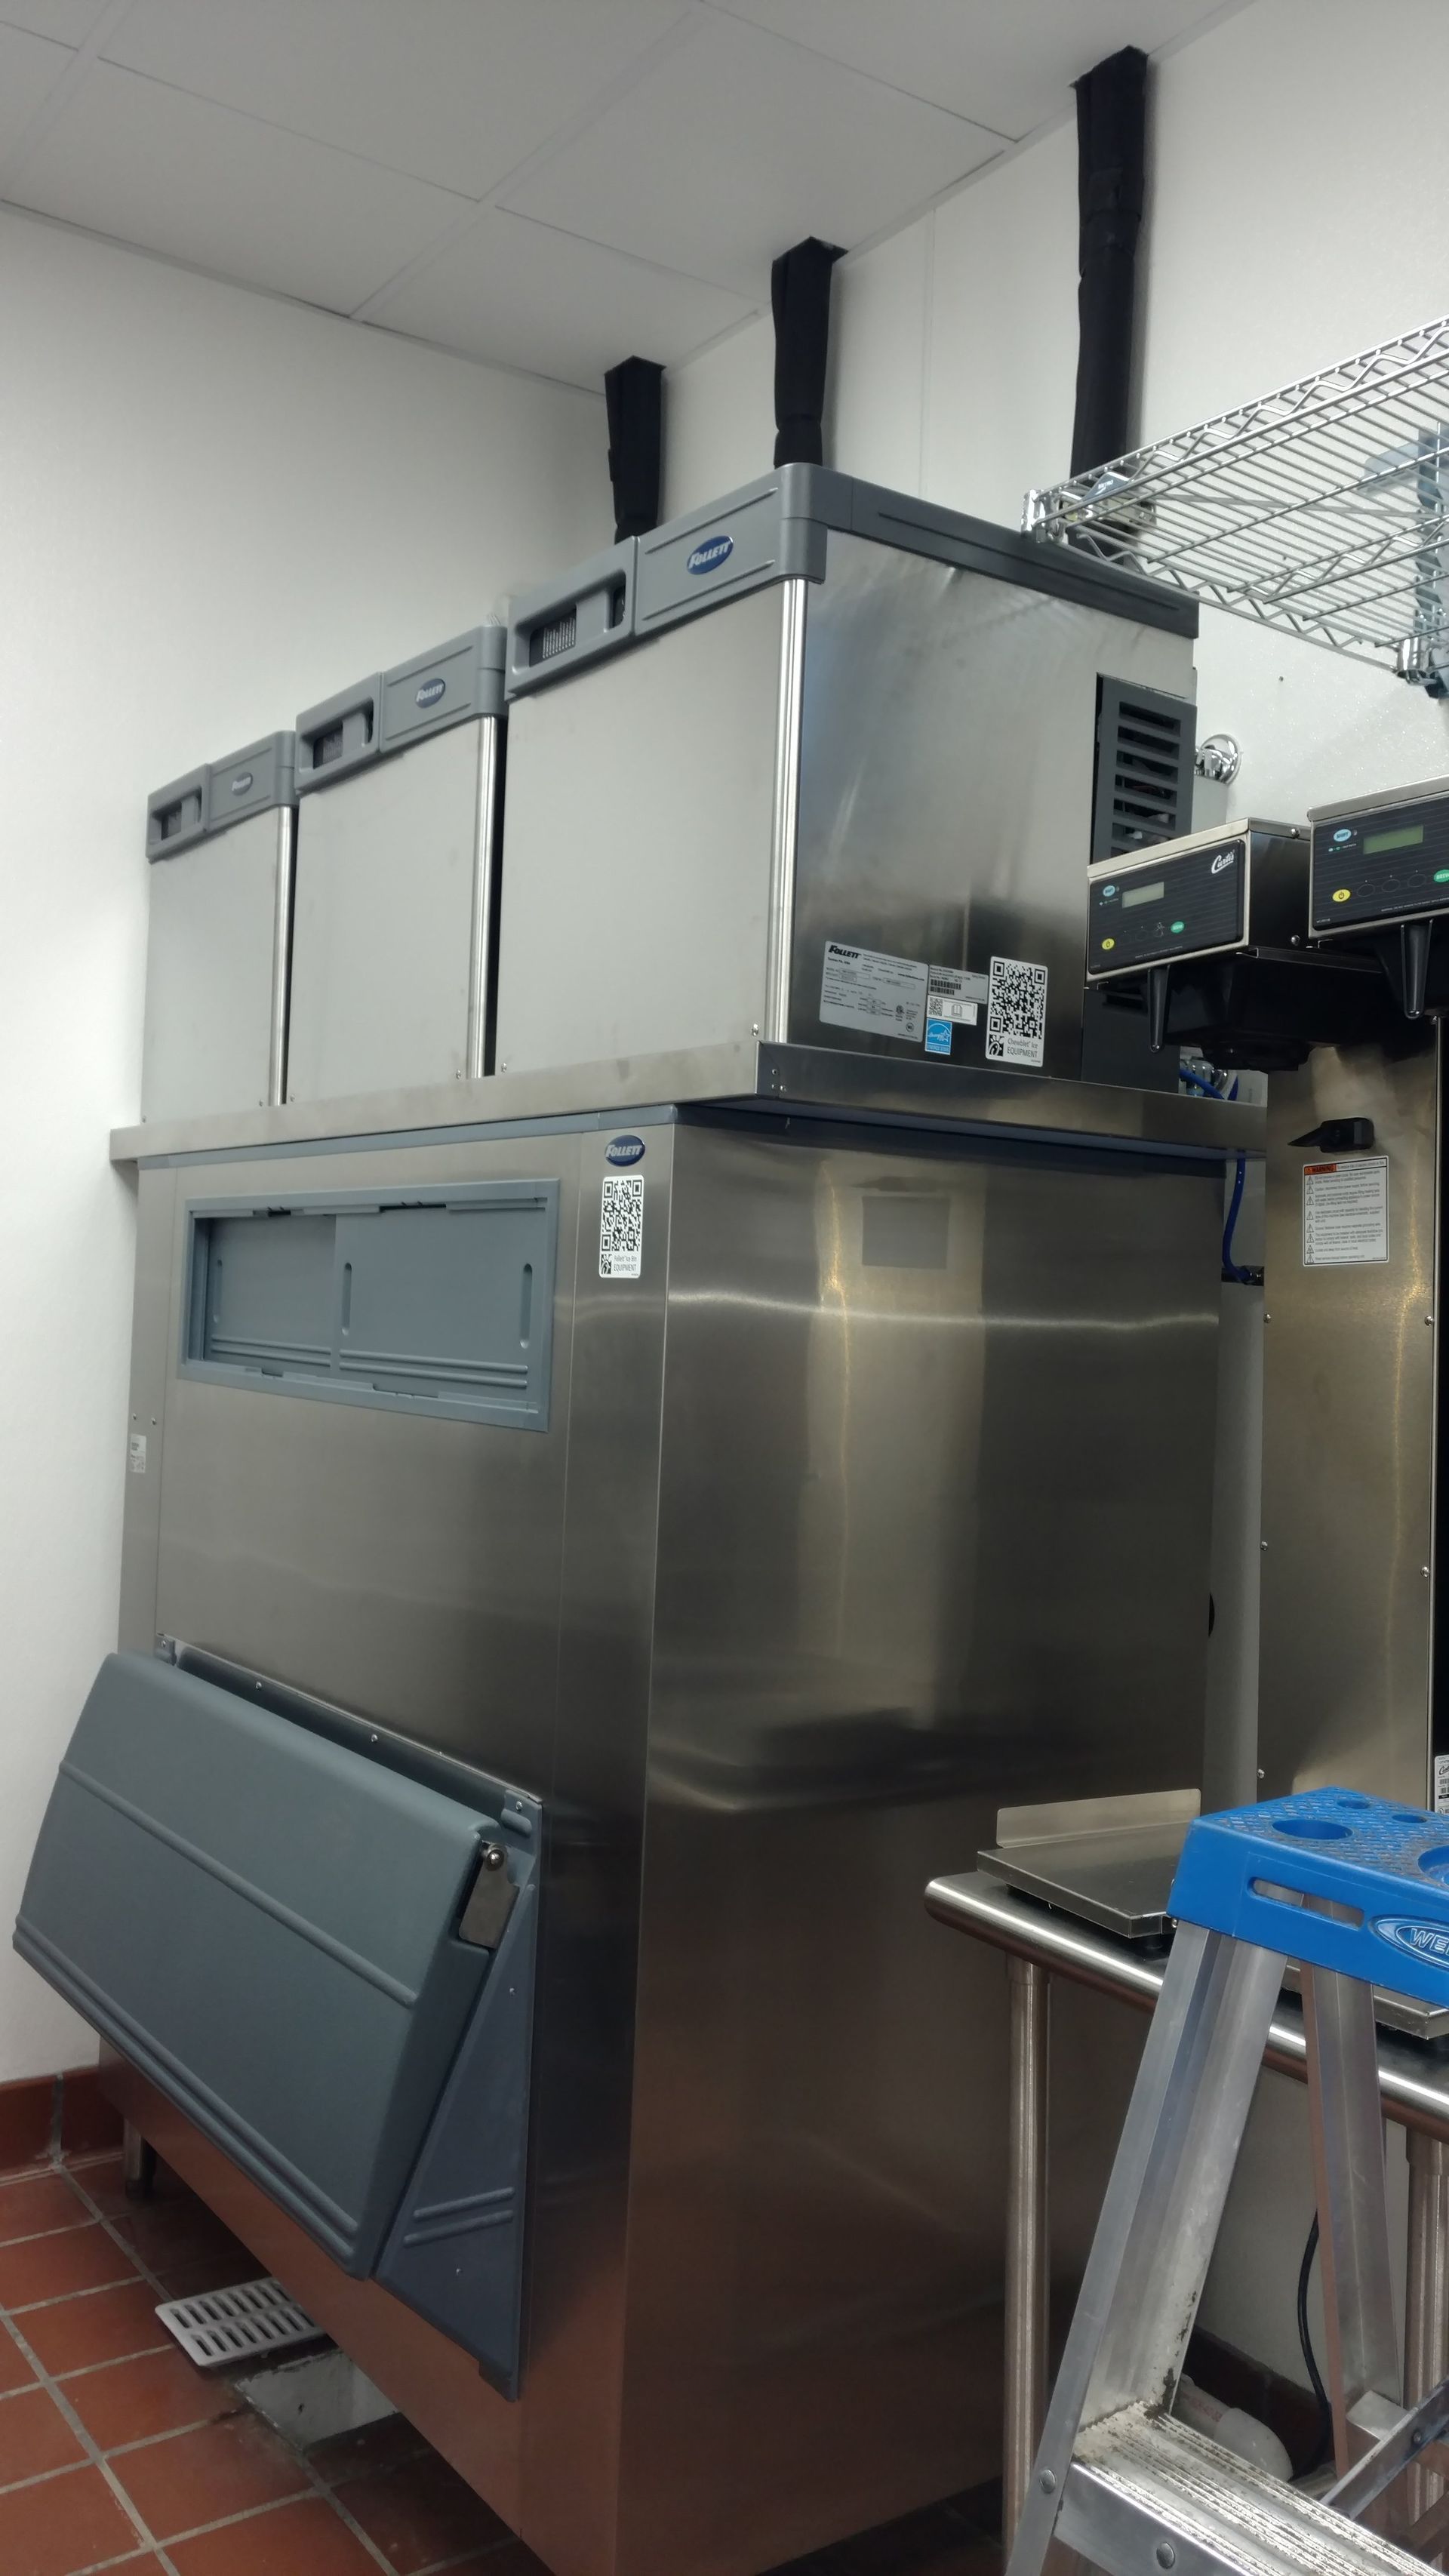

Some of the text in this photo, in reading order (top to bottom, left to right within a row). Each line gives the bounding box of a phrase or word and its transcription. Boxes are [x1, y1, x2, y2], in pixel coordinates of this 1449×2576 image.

[688, 540, 731, 569] FOLLETT
[829, 944, 862, 959] FOLLETT
[1007, 1047, 1038, 1057] EQUIPMENT
[605, 1144, 642, 1158] FOLLETT
[1410, 1928, 1449, 1956] WE
